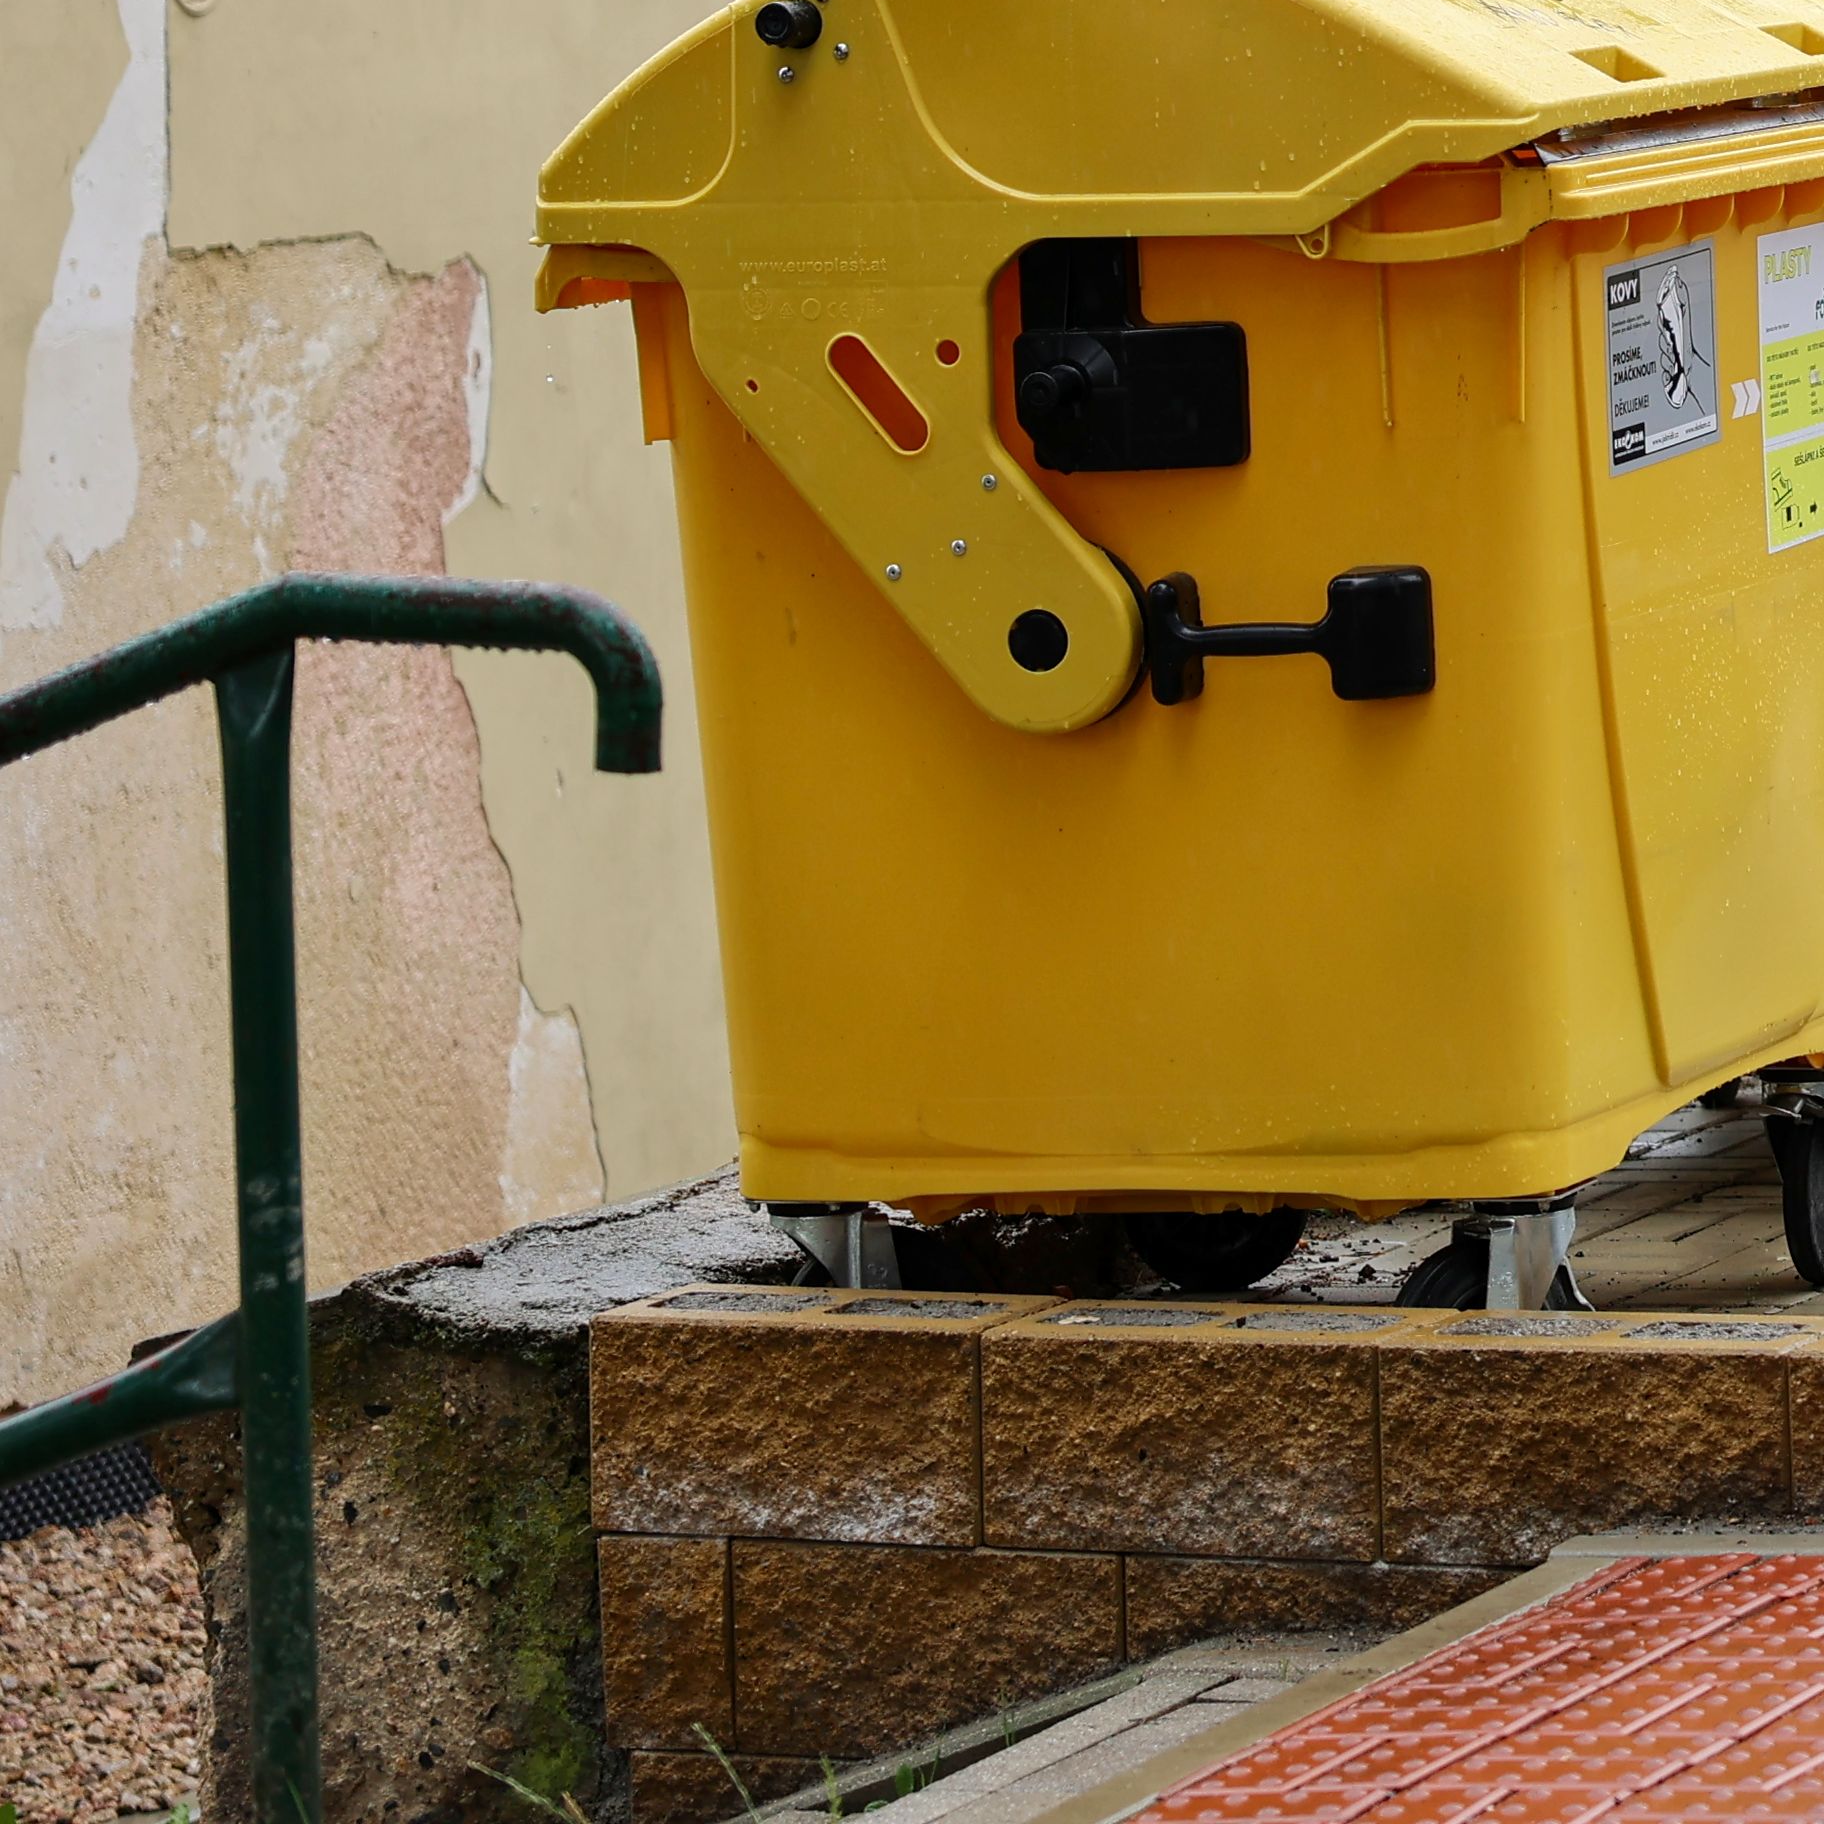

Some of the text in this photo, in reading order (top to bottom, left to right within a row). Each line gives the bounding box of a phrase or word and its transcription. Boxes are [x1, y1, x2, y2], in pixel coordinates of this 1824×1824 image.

[739, 257, 888, 274] www.europlast.at
[1764, 245, 1812, 284] PLASTY
[1610, 278, 1638, 305] KOVY
[1612, 346, 1643, 367] PROSÍME,
[1613, 361, 1657, 386] ZMÁČKNOUT!
[1614, 394, 1649, 418] DĚKUJEME!
